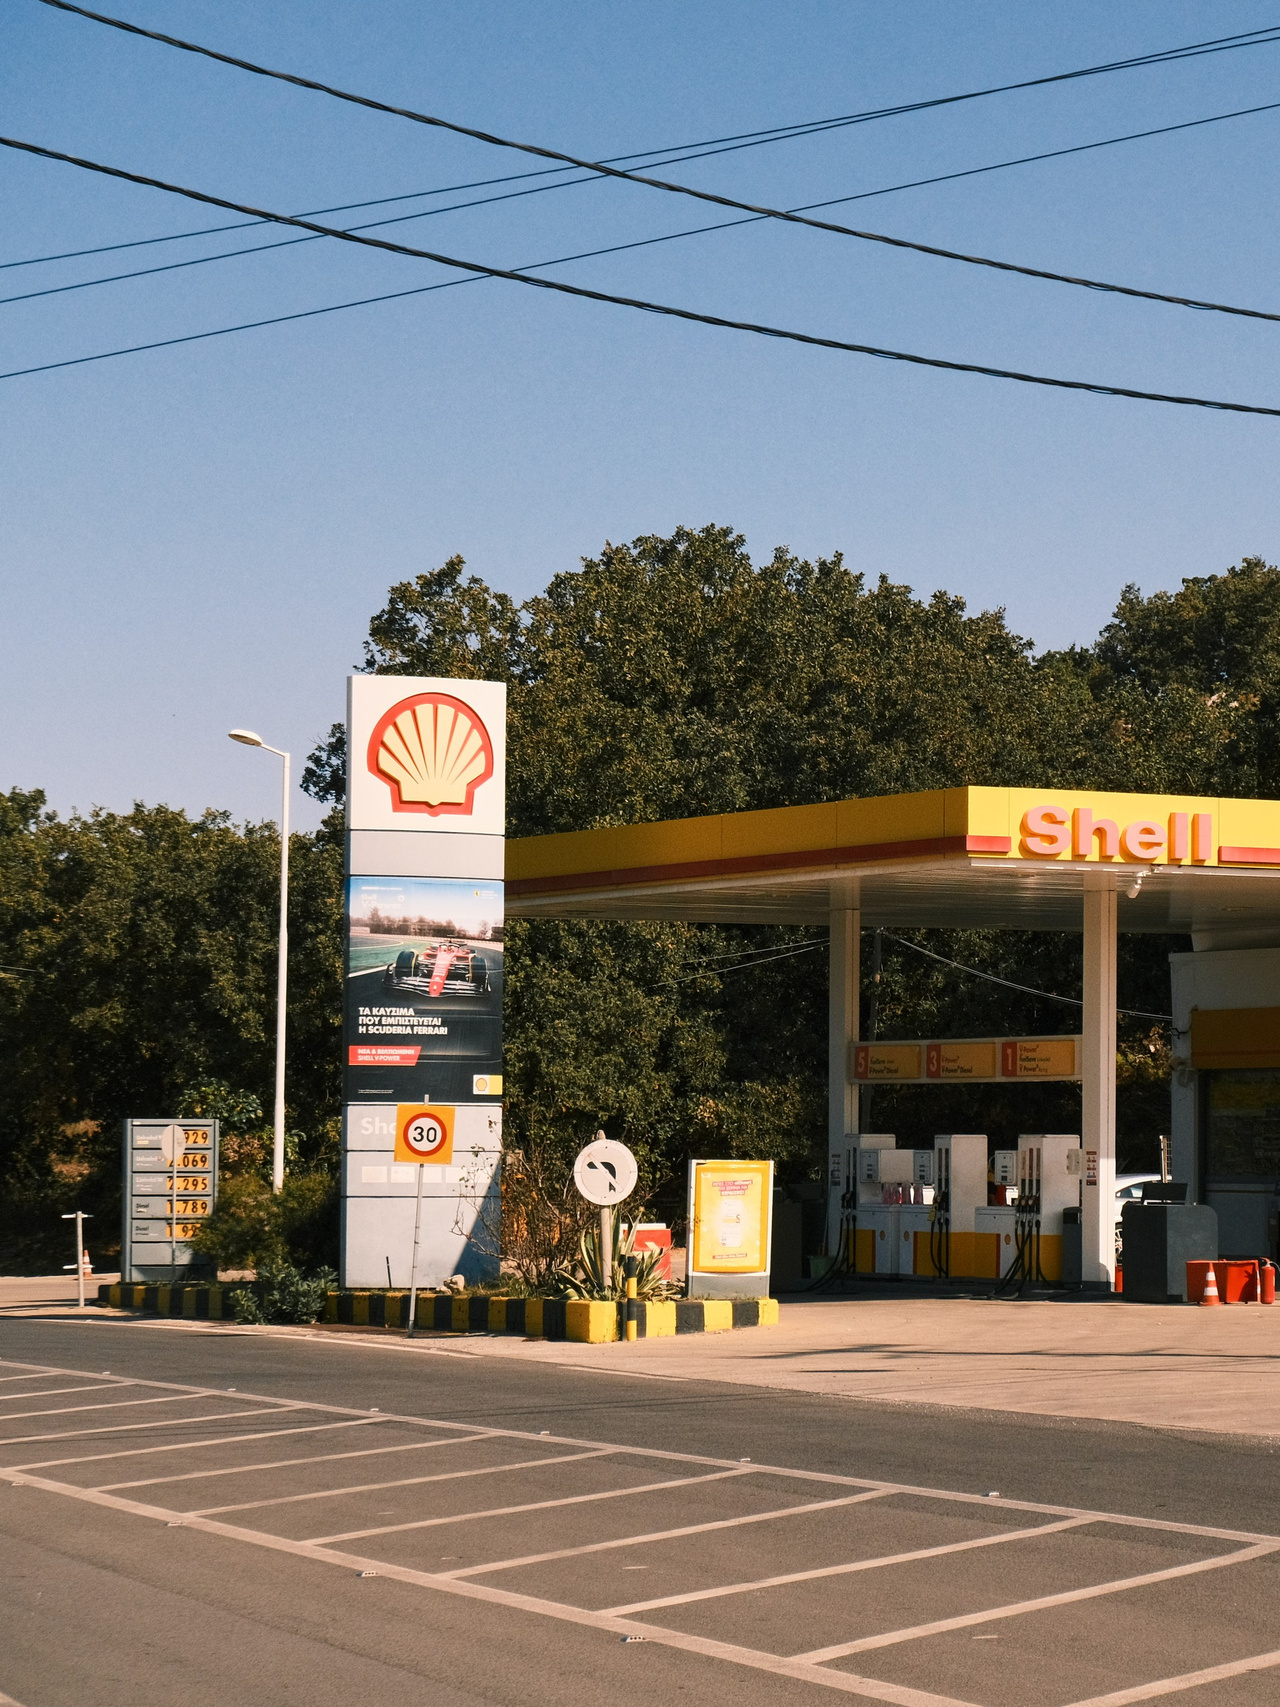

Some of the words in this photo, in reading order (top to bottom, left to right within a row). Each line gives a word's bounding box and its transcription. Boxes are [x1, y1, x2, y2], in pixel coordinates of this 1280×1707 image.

[1019, 805, 1212, 860] Shell
[358, 1007, 371, 1016] ΤΑ
[372, 1007, 415, 1016] ΚΑΥΣΙΜΑ
[358, 1016, 381, 1025] ΠΟΥ
[381, 1017, 442, 1026] ΕΜΠΙΣΤΕΥΕΤΑΙ
[367, 1026, 412, 1035] SCUDERIA
[413, 1026, 448, 1035] FERRARI
[857, 1052, 865, 1073] 5
[929, 1050, 937, 1072] 3
[1006, 1048, 1012, 1071] 1
[412, 1126, 437, 1143] 30
[168, 1178, 207, 1191] 2.295
[169, 1201, 208, 1214] 1.789
